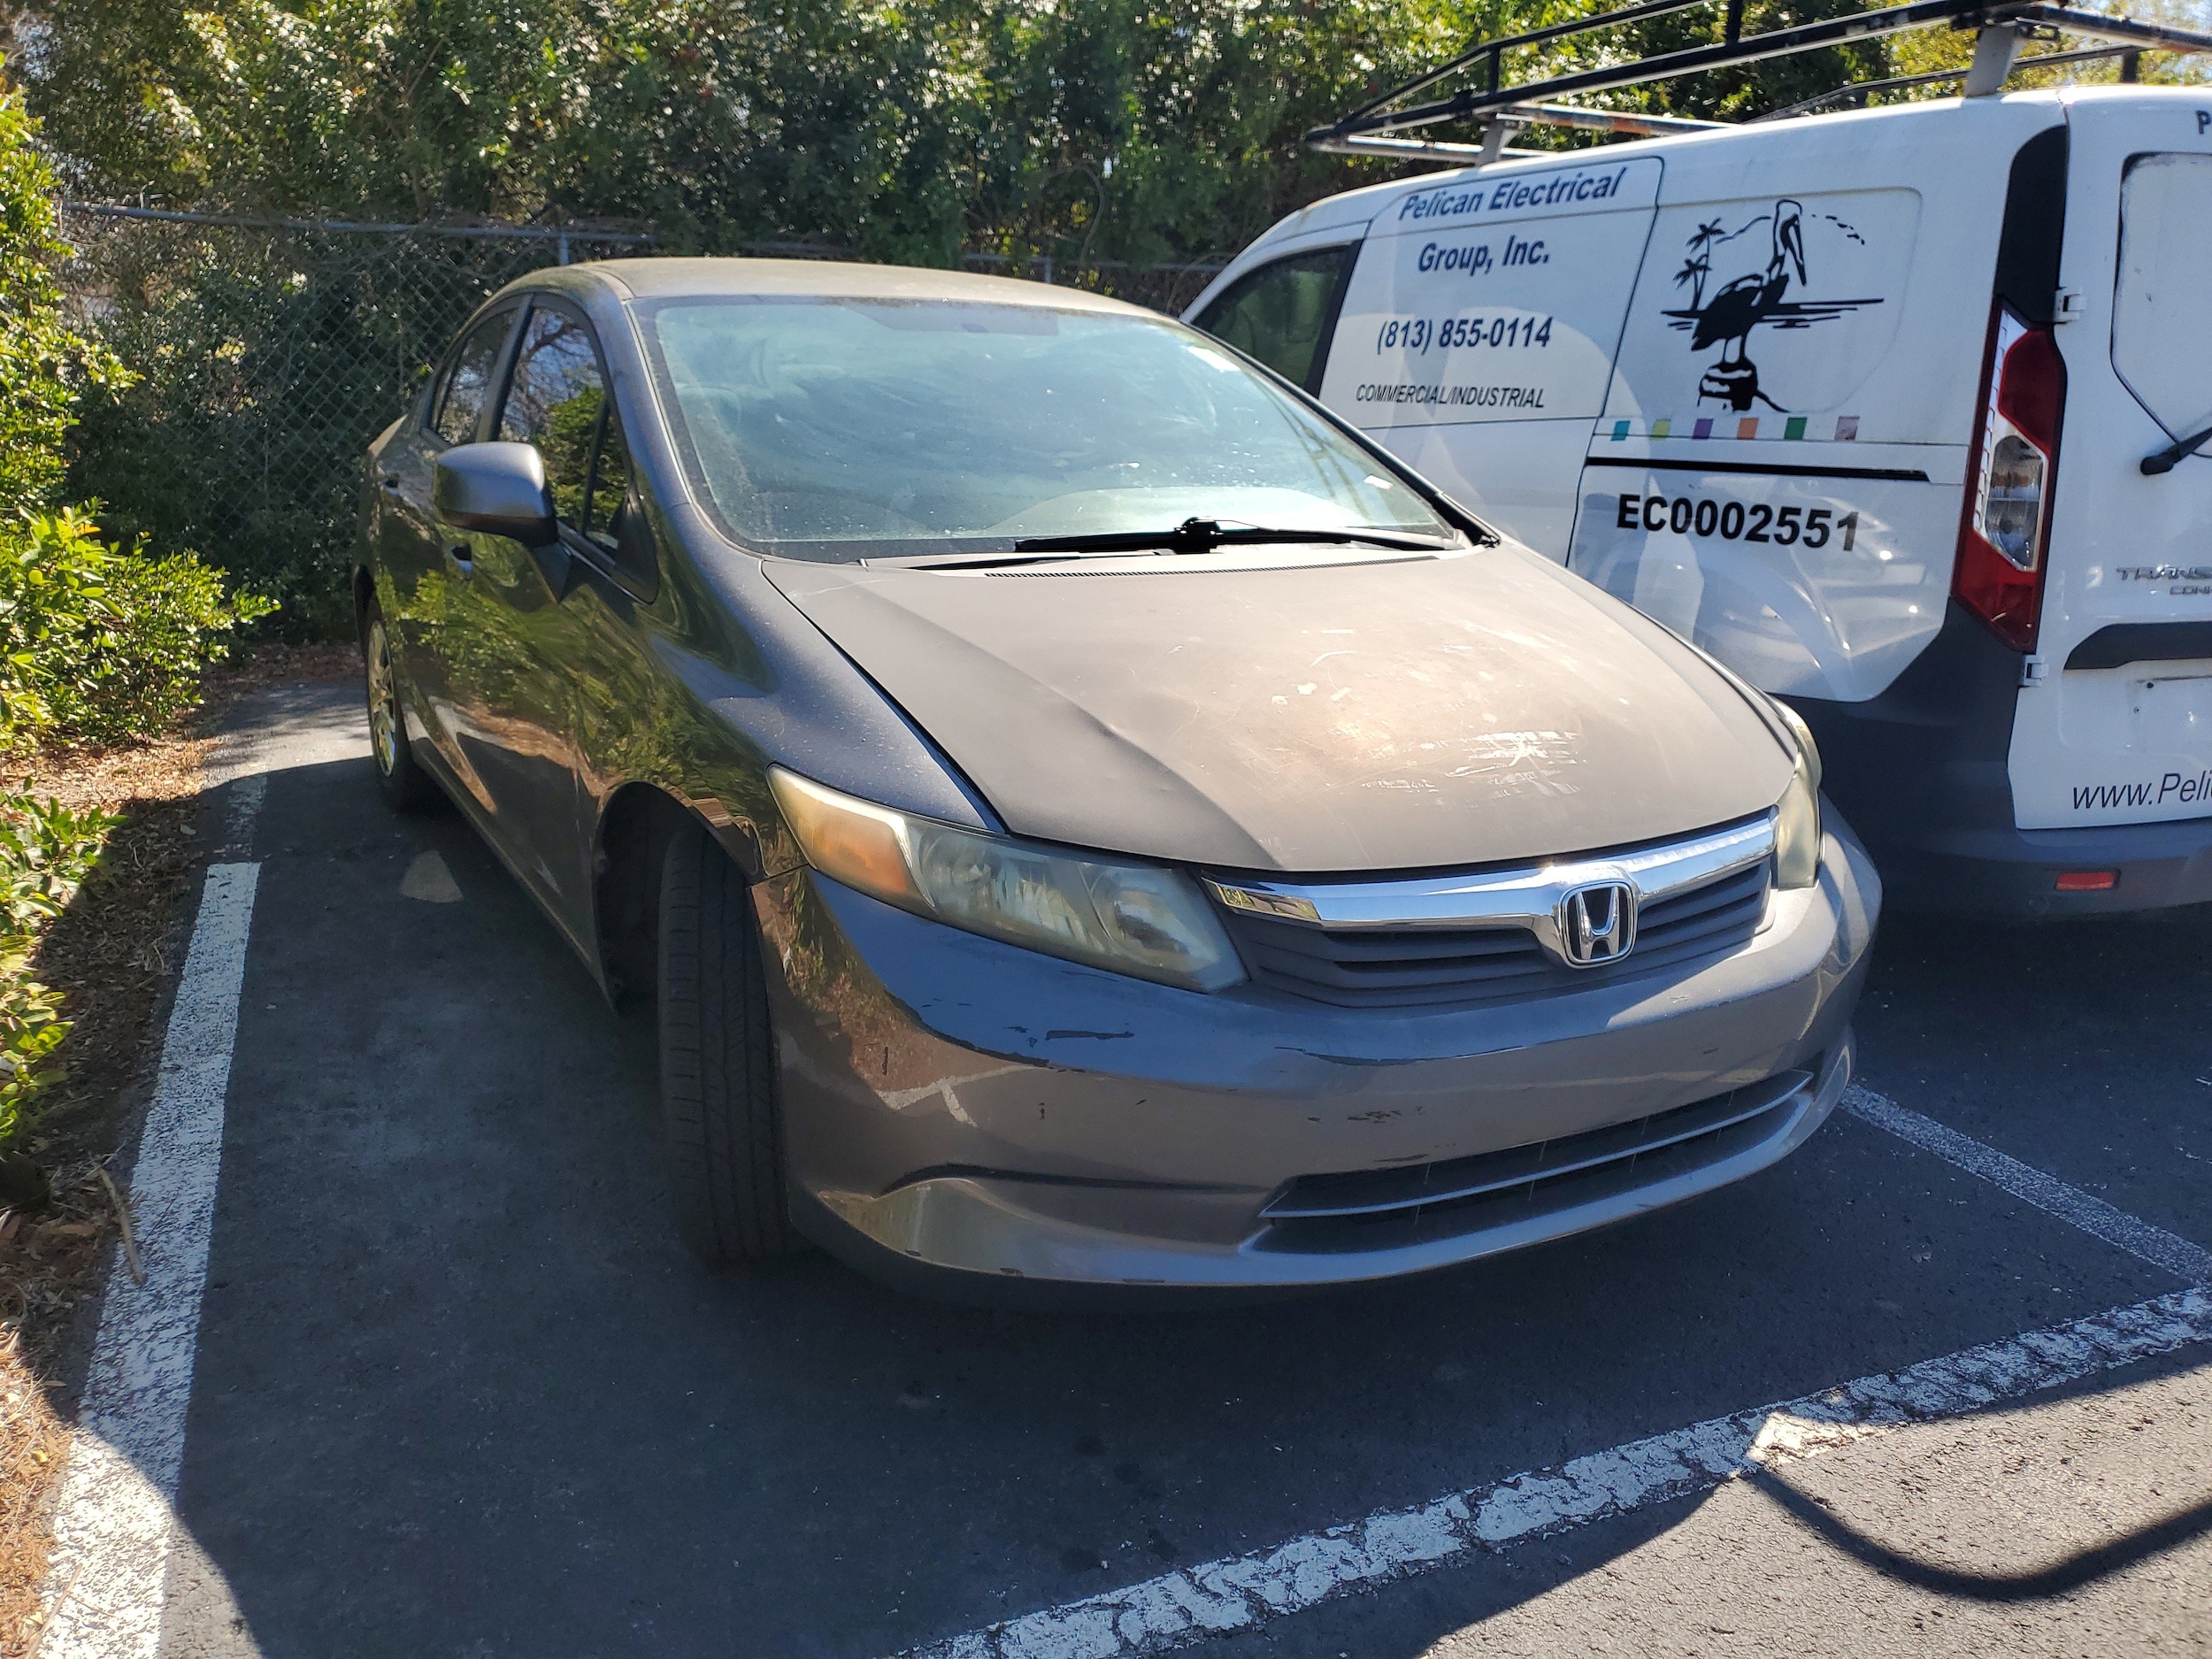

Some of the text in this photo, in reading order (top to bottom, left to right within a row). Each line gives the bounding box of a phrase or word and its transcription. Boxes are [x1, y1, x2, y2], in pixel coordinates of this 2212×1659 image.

[1397, 166, 1627, 221] Pelican Electrical
[1417, 234, 1550, 276] Group, Inc.
[1377, 316, 1553, 355] (813) 855-0114
[1355, 383, 1546, 409] COMMERCIAL/INDUSTRIAL
[1617, 493, 1859, 551] EC0002551
[2072, 769, 2212, 810] www.Peli
